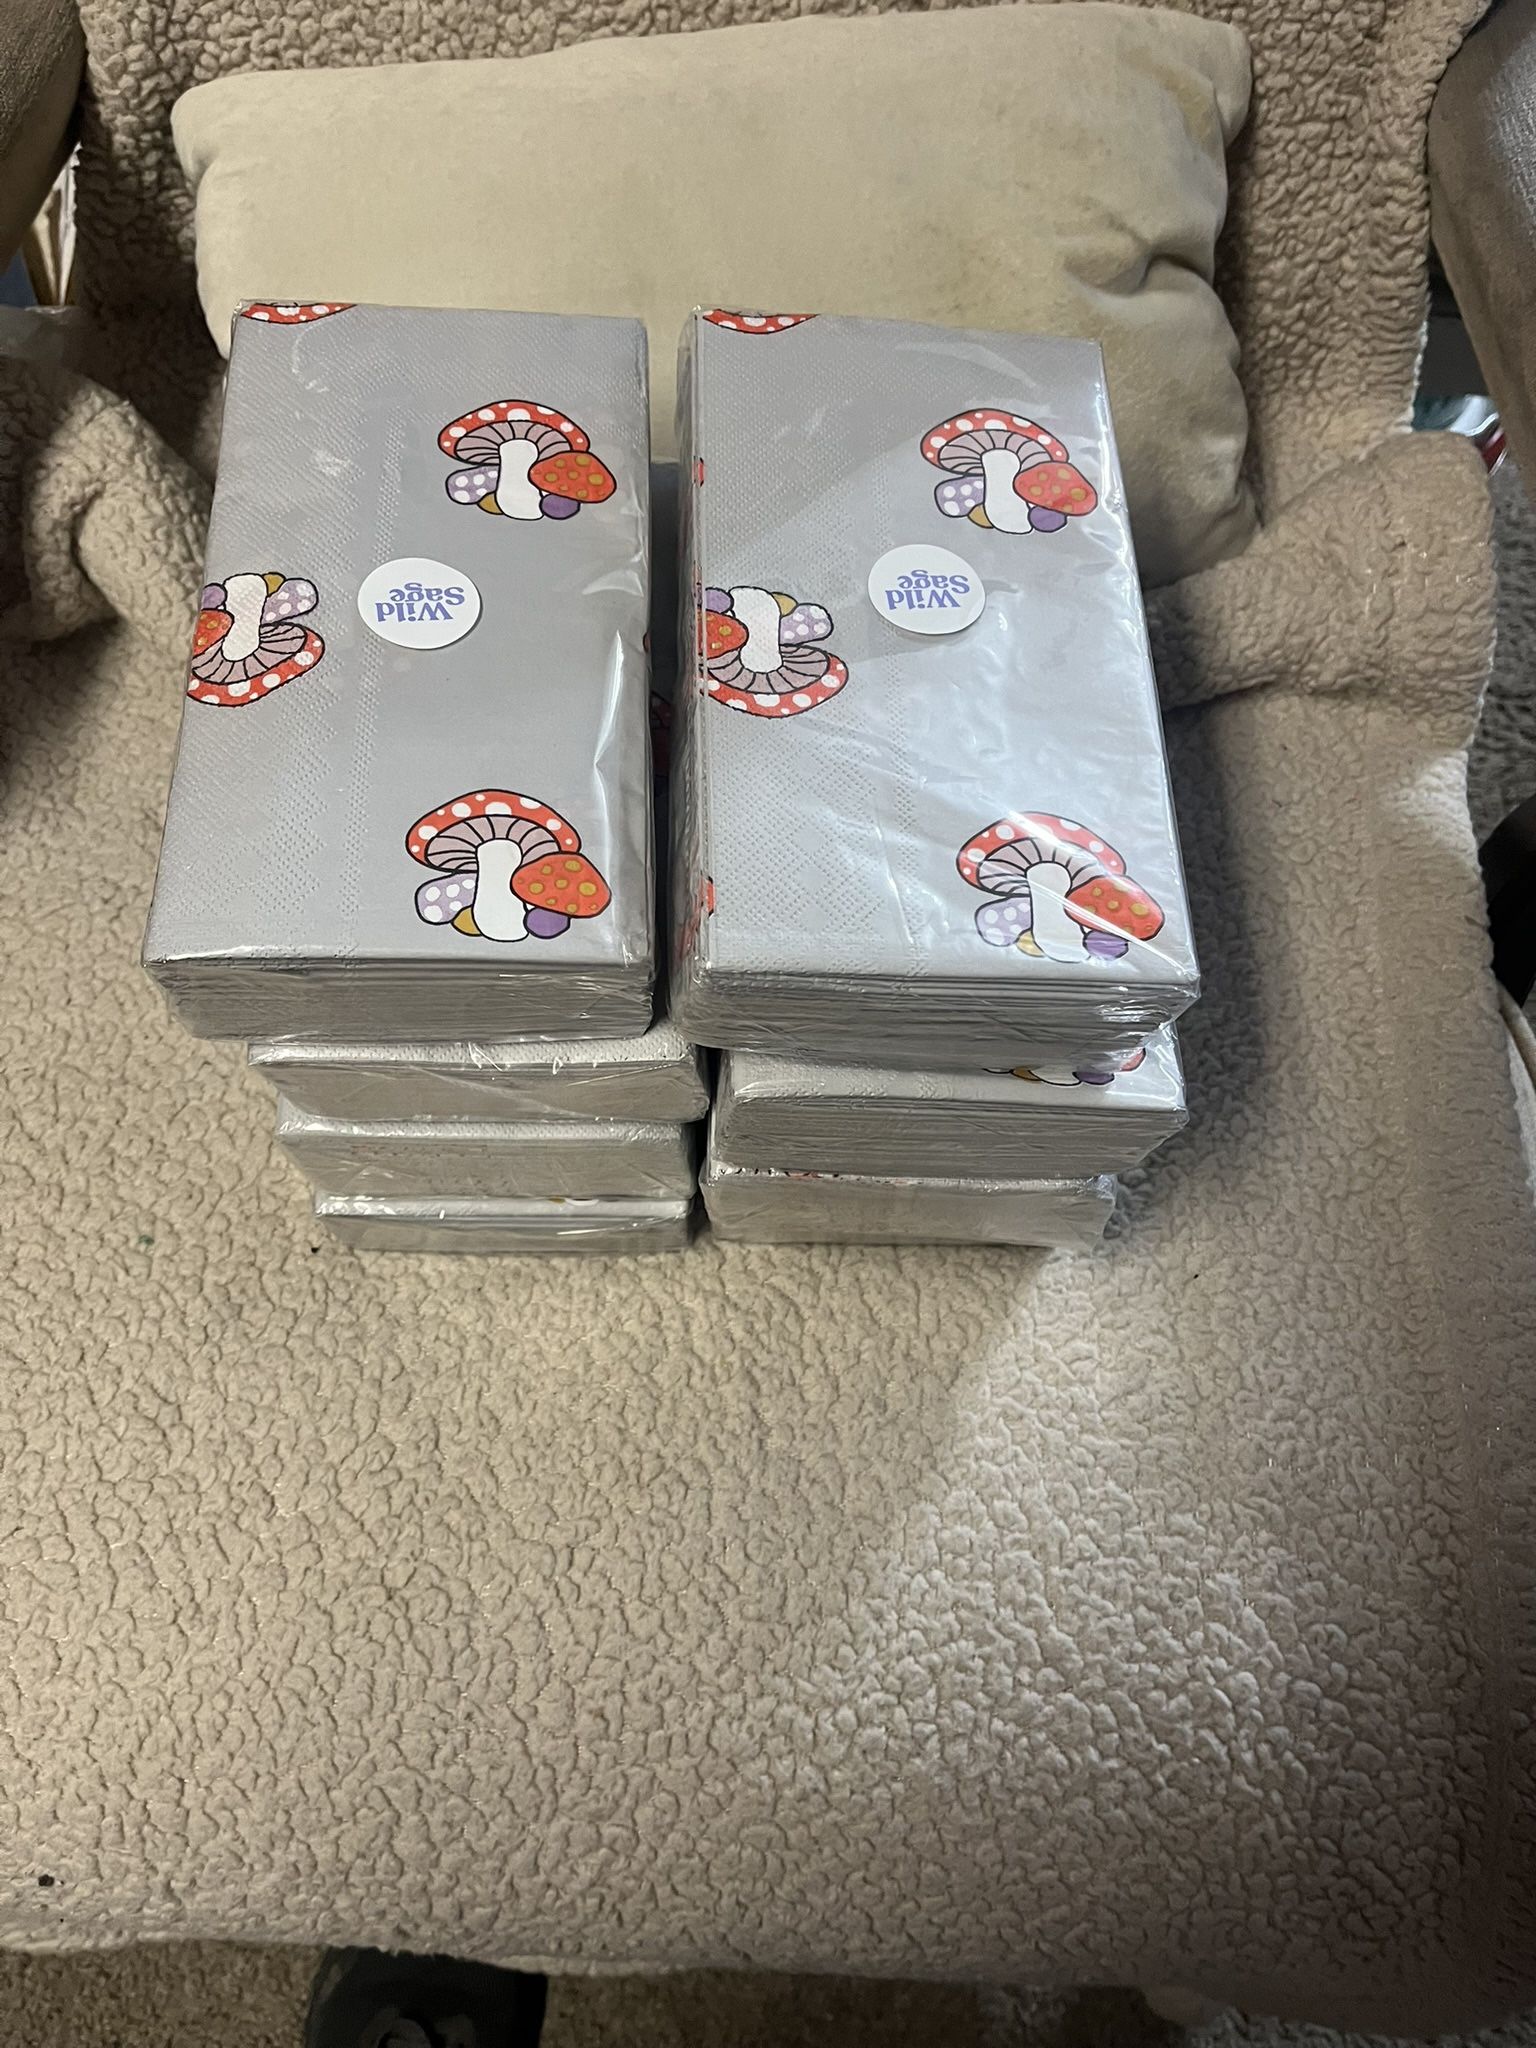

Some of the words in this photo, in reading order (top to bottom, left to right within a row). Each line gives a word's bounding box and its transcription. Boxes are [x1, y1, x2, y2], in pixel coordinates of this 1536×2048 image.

[897, 569, 970, 594] Sage
[389, 582, 465, 605] Sage
[885, 589, 960, 610] Wild
[375, 602, 453, 622] Wild
